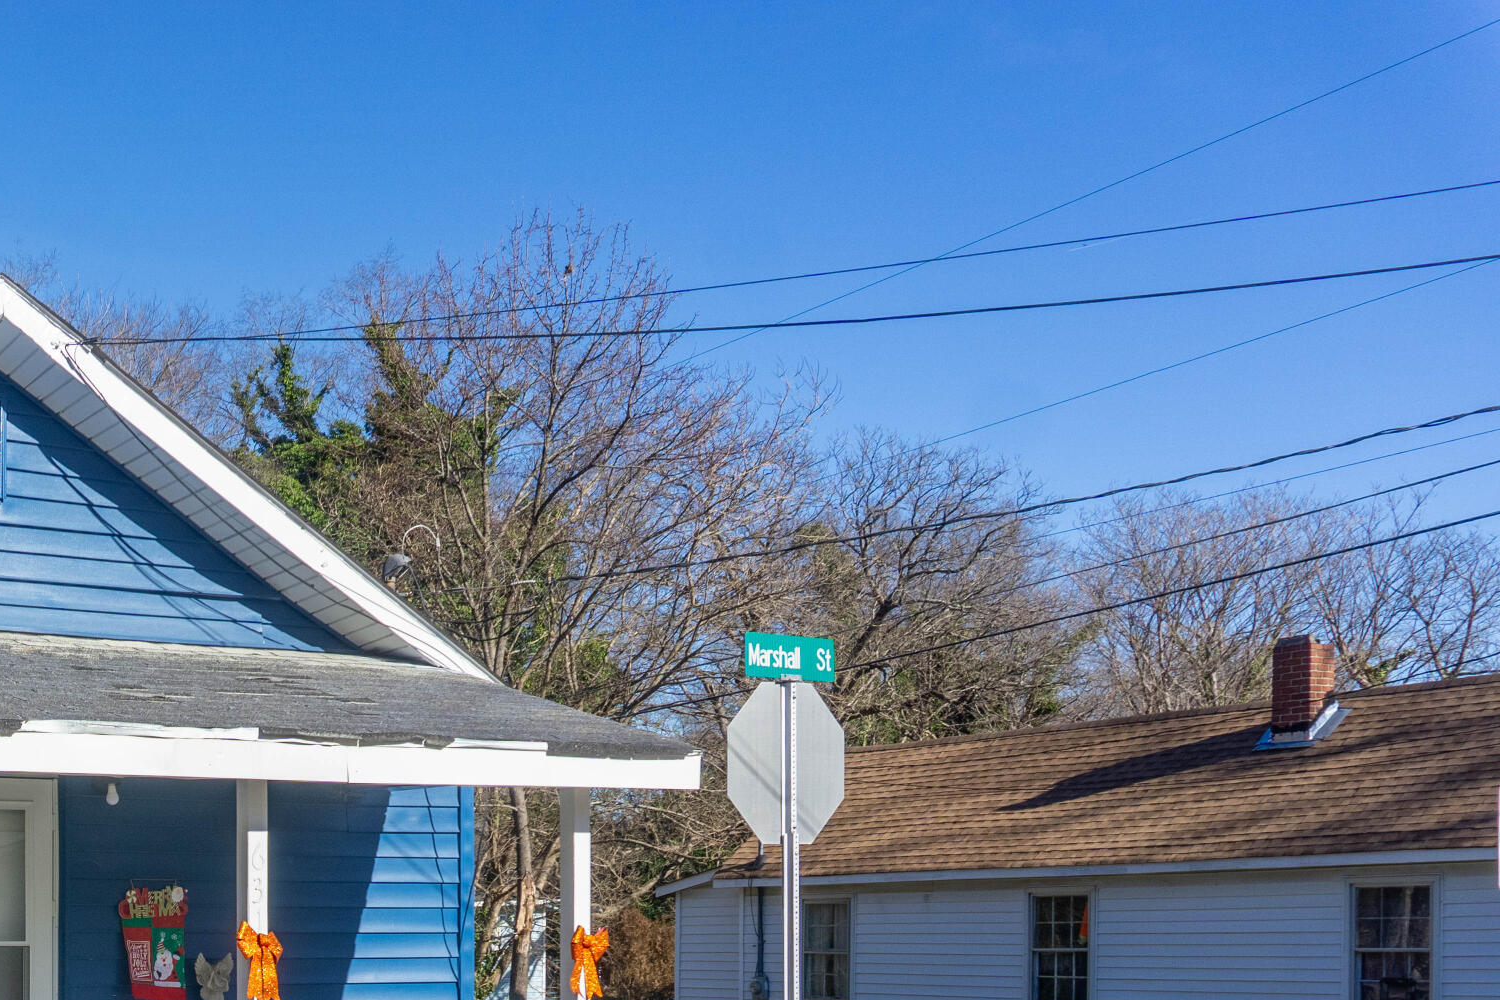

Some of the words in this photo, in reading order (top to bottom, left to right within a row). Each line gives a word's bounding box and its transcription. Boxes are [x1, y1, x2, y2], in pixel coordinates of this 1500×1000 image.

[748, 643, 801, 669] Marshall
[816, 648, 832, 672] St
[134, 885, 182, 904] MERR
